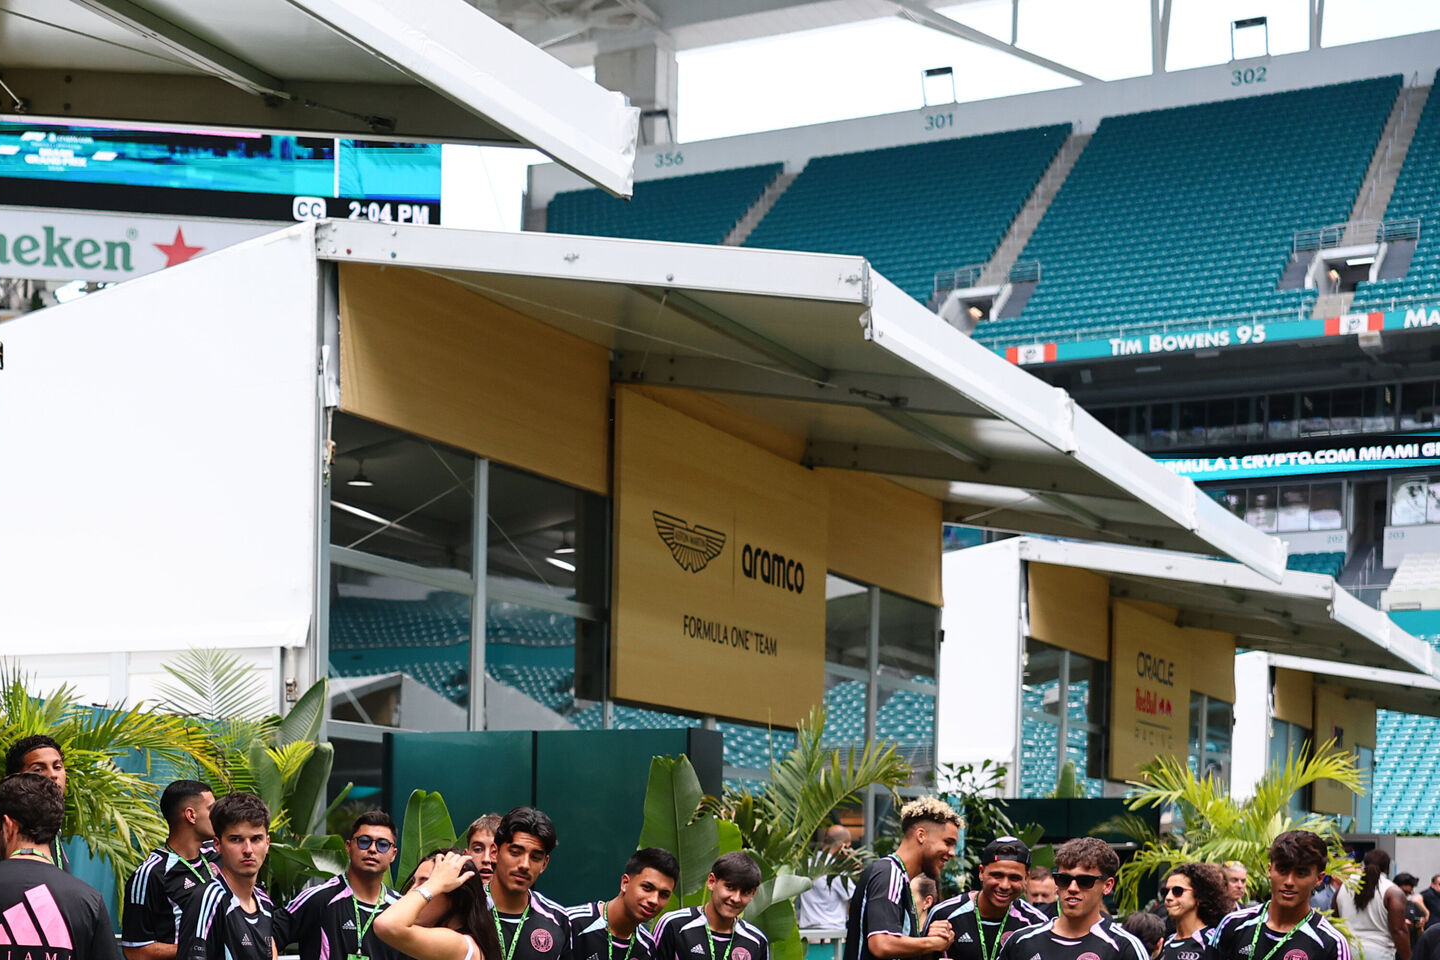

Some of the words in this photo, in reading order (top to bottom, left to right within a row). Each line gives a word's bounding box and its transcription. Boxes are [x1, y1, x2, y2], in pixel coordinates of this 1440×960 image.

[1231, 66, 1267, 86] 302
[924, 112, 953, 131] 301
[654, 151, 684, 169] 356
[297, 202, 322, 217] CC
[348, 201, 393, 221] 2:04
[397, 204, 429, 224] PM
[1236, 325, 1266, 345] 95
[1229, 456, 1239, 470] 1
[1241, 447, 1357, 469] CRYPTO.COM
[1358, 443, 1419, 461] MIAMI
[1422, 441, 1440, 457] G
[742, 543, 805, 594] aramco
[683, 614, 729, 645] FORMULA
[755, 633, 777, 656] TEAM
[1136, 651, 1175, 687] ORACLE
